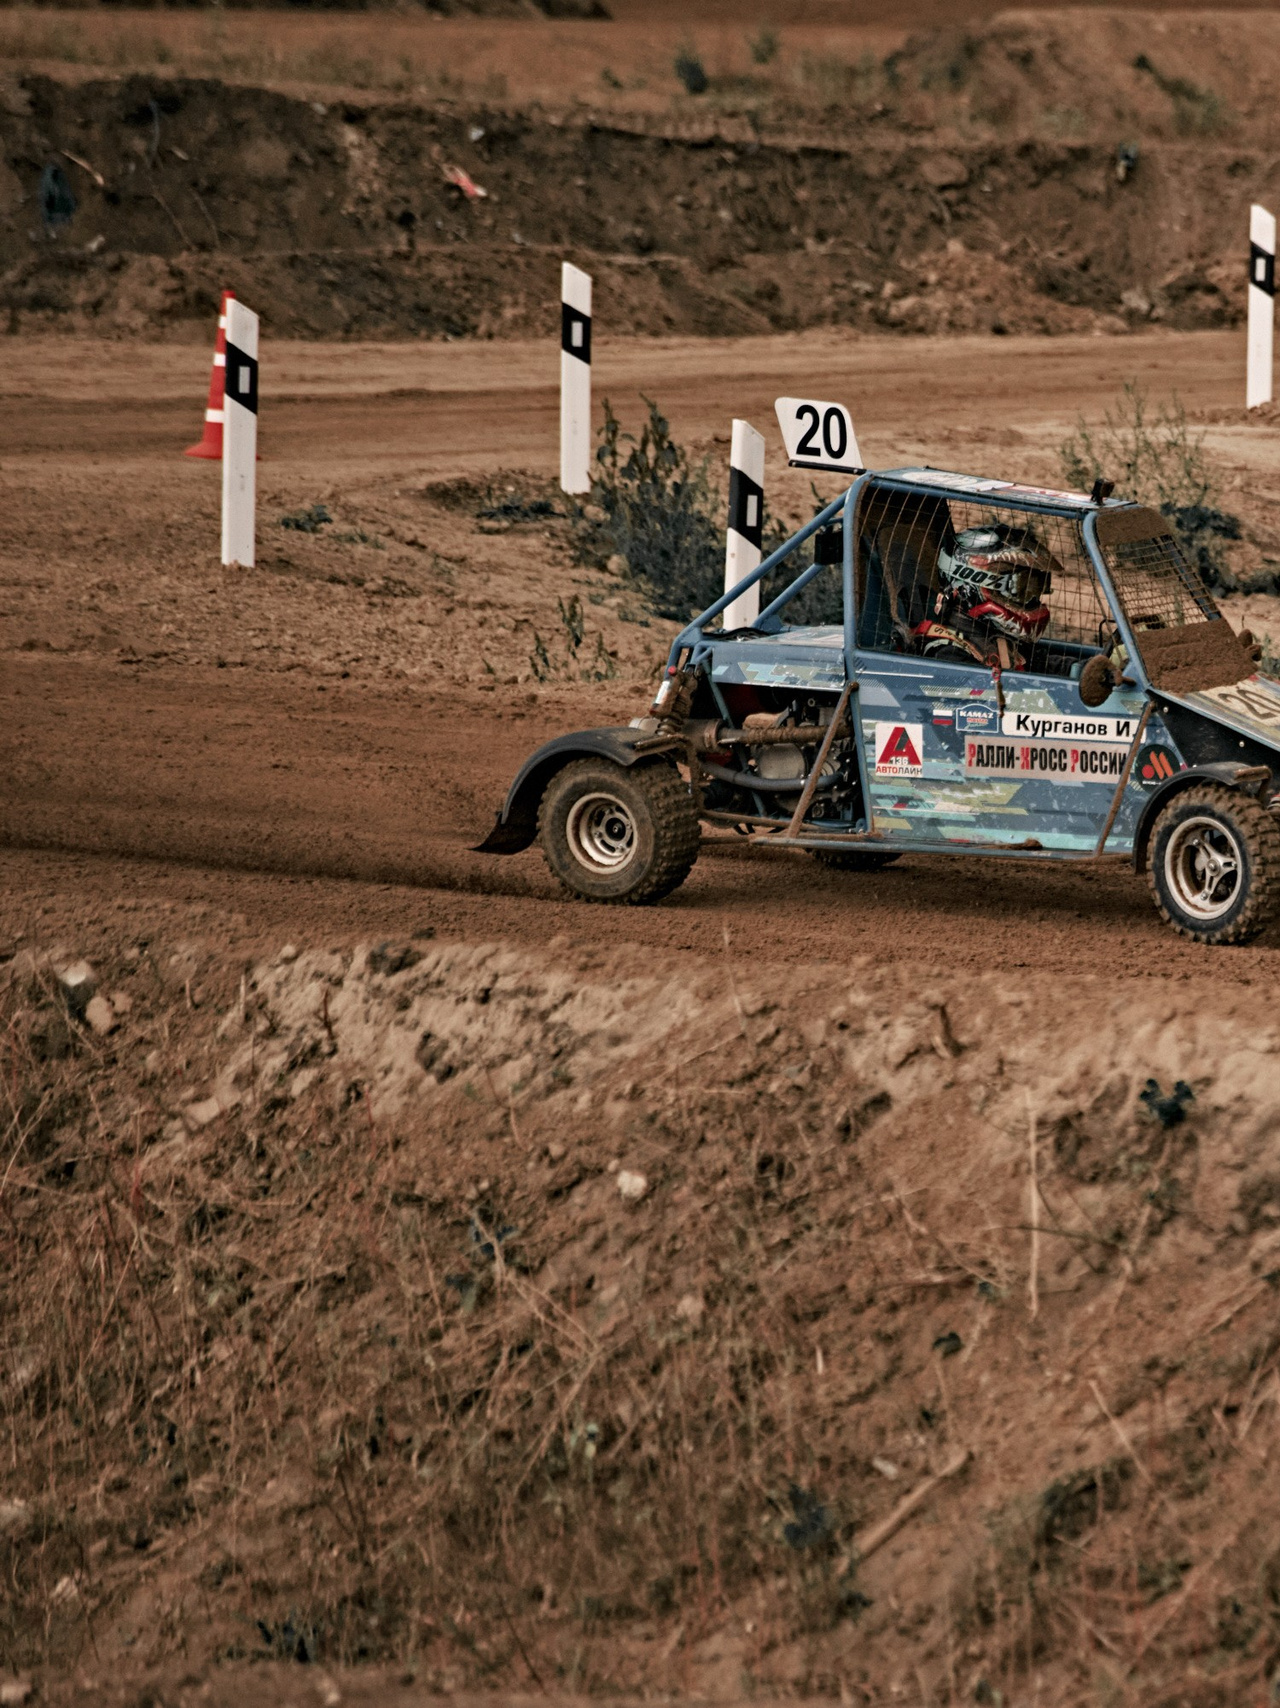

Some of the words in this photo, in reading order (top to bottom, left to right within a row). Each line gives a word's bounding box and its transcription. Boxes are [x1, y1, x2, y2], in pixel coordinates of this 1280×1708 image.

[796, 404, 847, 459] 20
[952, 564, 1004, 591] 100%
[960, 710, 994, 719] KAMAZ
[1016, 714, 1108, 738] Курганов
